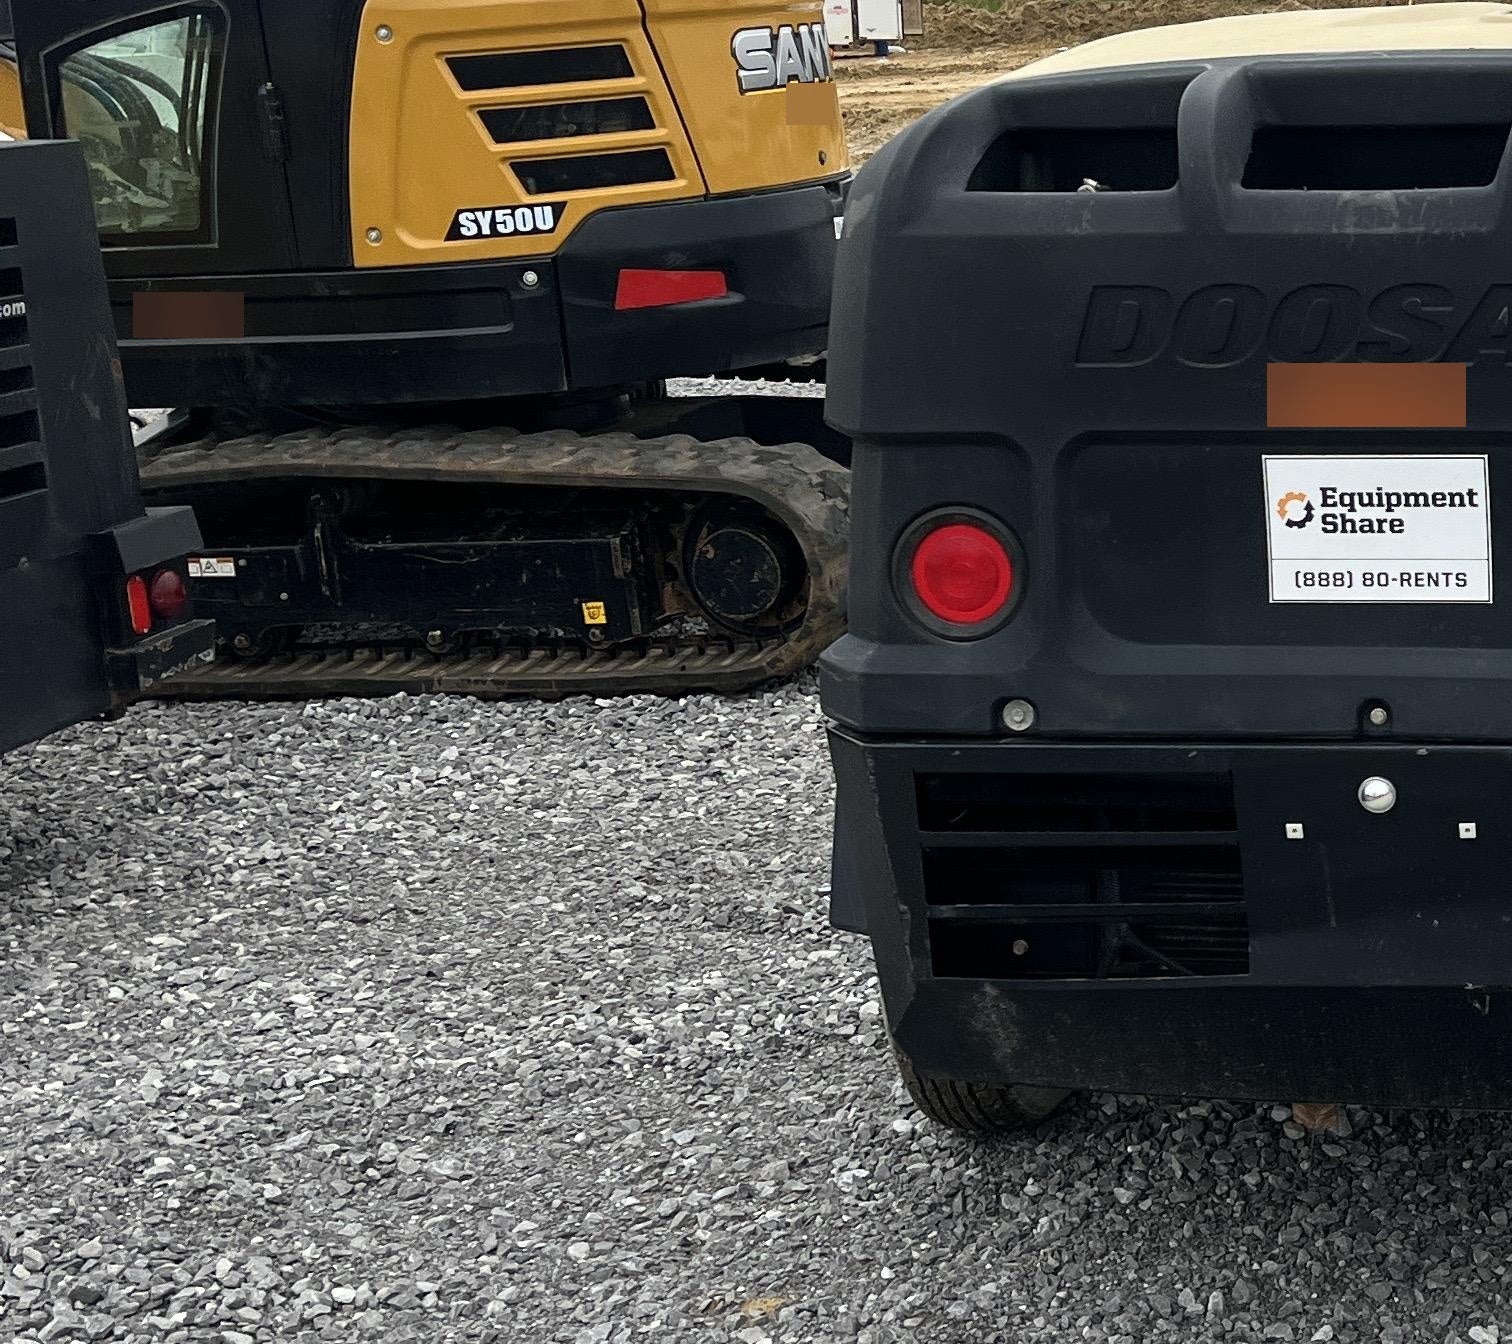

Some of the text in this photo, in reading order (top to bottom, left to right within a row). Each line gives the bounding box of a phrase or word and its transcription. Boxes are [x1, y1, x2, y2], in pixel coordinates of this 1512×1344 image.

[458, 205, 554, 236] SY50U
[1319, 487, 1478, 512] Equipment
[1321, 513, 1405, 534] Share
[1295, 570, 1468, 588] (888) 80-RENTS
